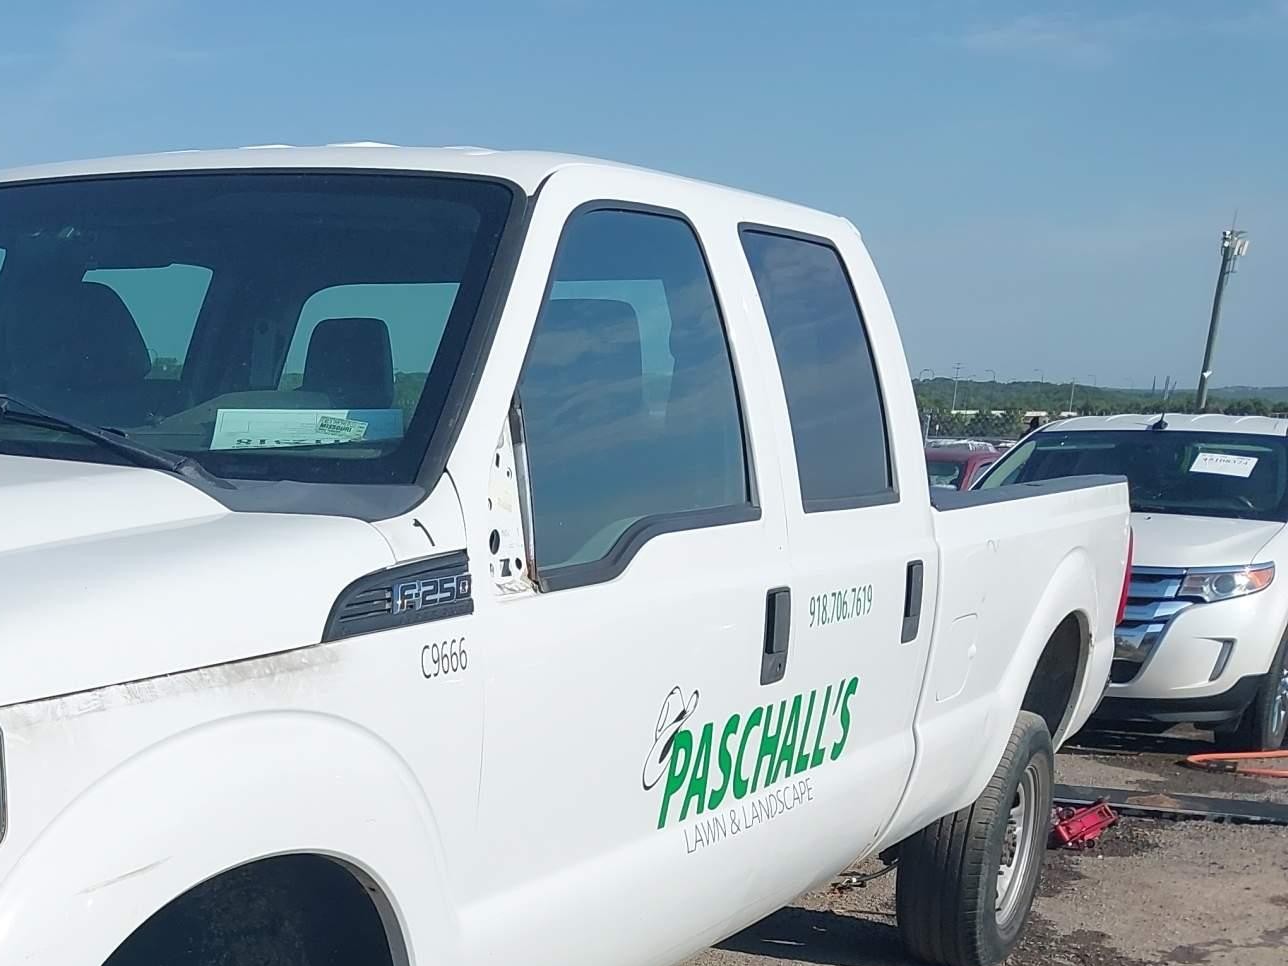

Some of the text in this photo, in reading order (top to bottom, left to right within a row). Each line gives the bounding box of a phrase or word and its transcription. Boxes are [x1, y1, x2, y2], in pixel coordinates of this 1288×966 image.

[809, 583, 873, 628] 918.706.7619
[421, 637, 468, 679] C9666
[657, 676, 860, 830] PASCHALL'S
[683, 777, 814, 854] LAWN & LANDSCAPE
